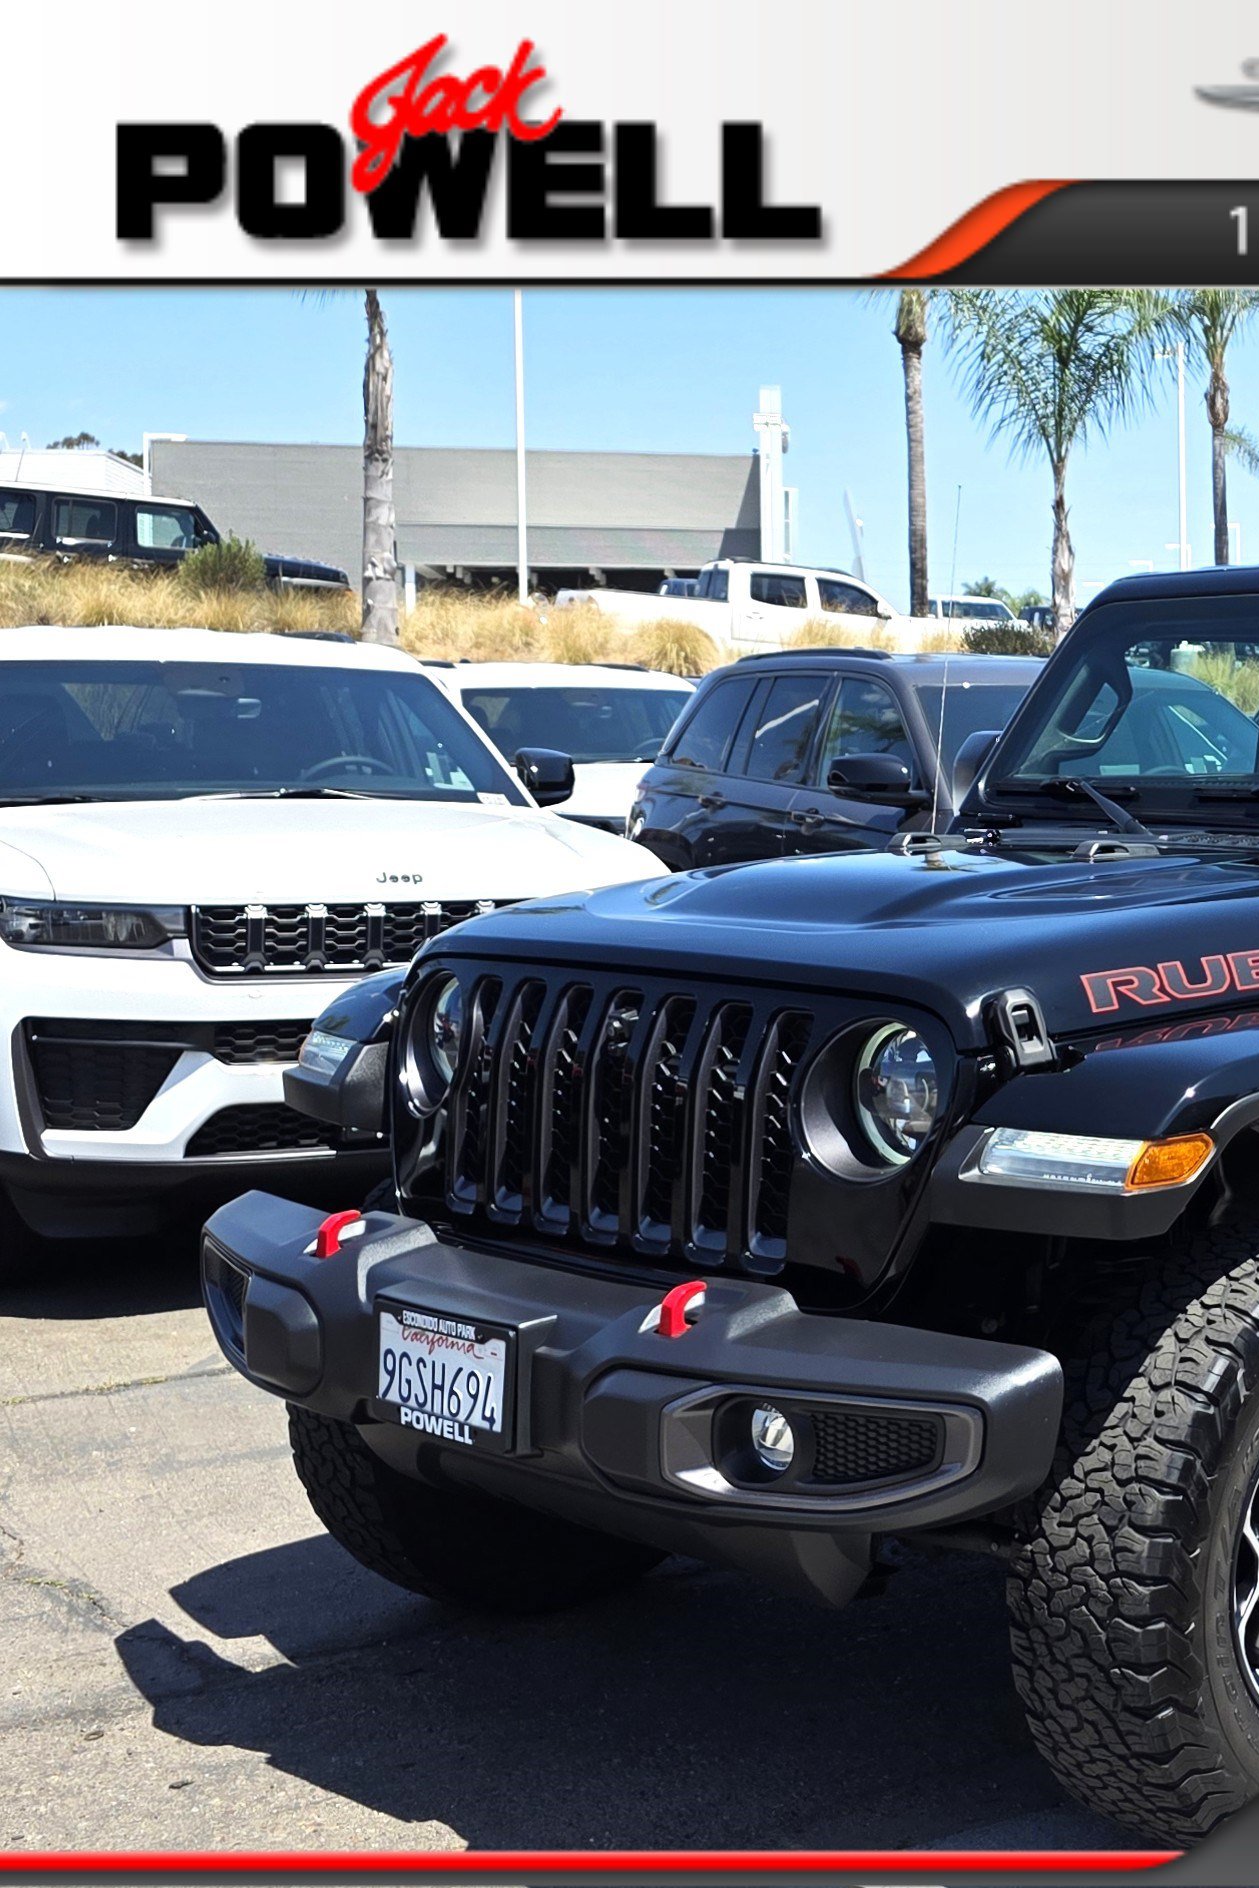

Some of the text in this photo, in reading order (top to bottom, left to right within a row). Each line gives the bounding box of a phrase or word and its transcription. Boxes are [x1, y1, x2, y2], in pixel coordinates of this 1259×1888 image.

[376, 871, 423, 885] Jeep
[402, 1309, 476, 1341] ESCONDIDO AUTO PARK
[381, 1347, 497, 1431] 9GSH694
[400, 1405, 474, 1446] POWELL
